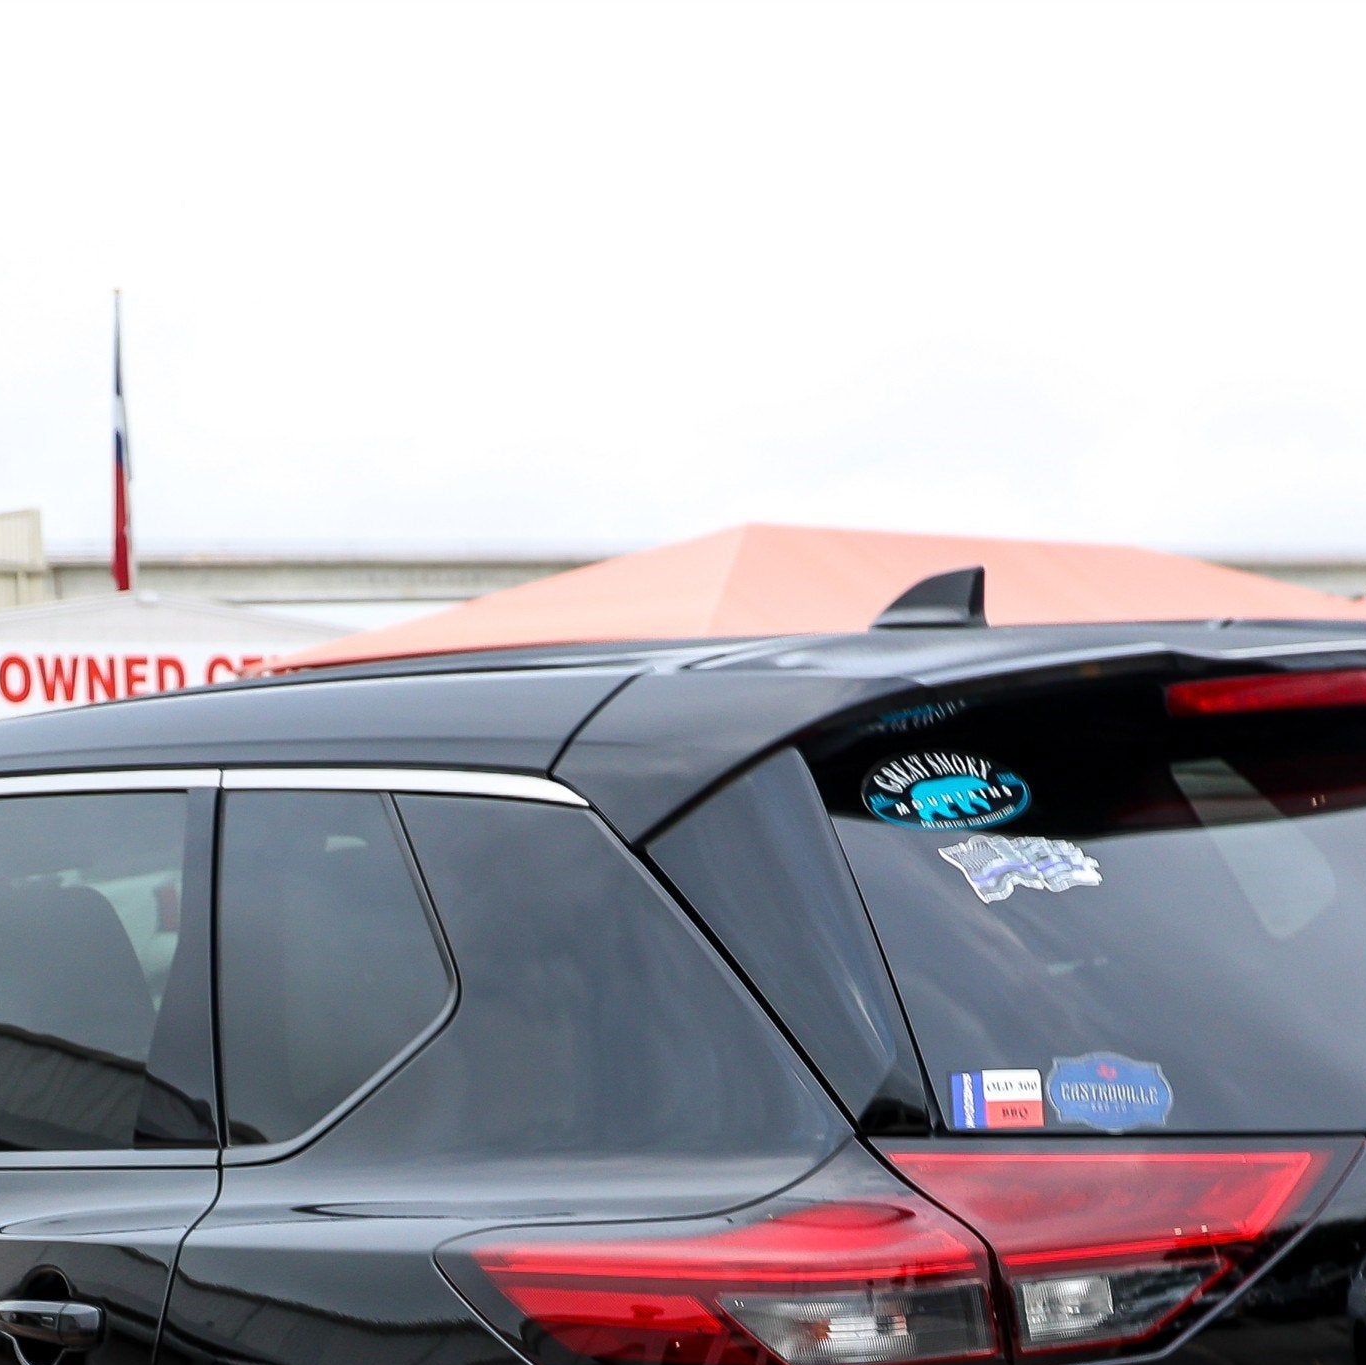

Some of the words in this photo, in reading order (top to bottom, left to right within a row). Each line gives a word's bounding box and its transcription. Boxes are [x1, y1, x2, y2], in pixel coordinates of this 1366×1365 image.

[873, 753, 931, 794] GREAT
[924, 752, 992, 781] SMOKY
[895, 784, 1013, 816] MOUNTAINS
[985, 1080, 1014, 1093] OLD
[1001, 1106, 1030, 1120] BBQ
